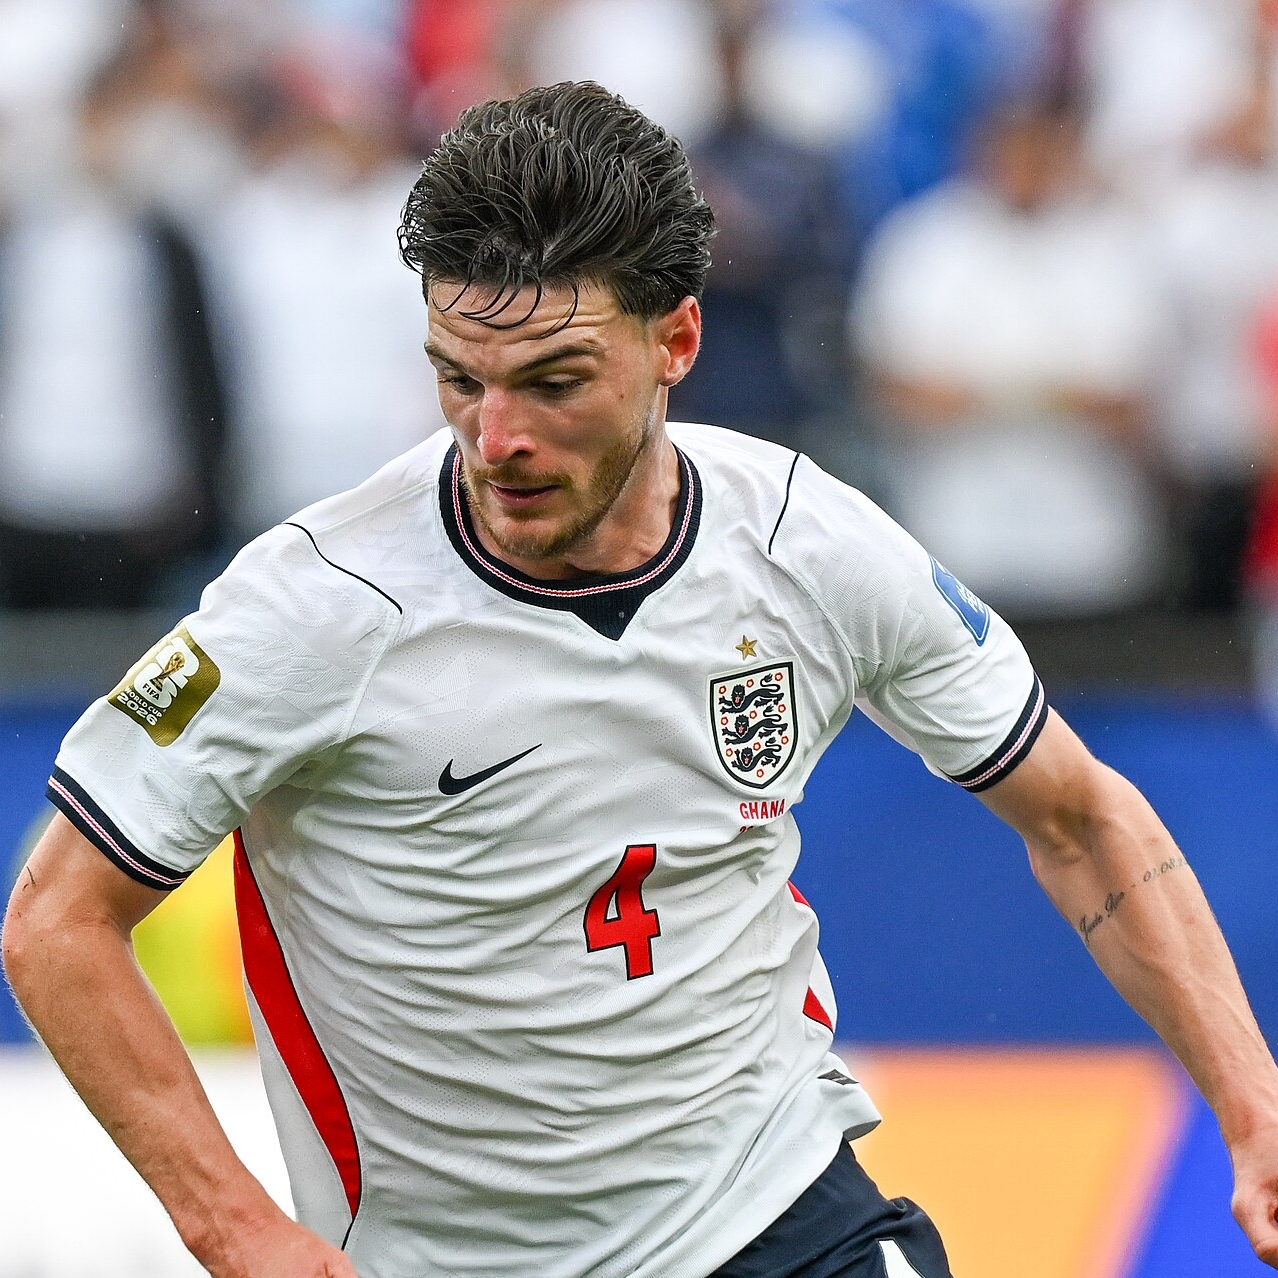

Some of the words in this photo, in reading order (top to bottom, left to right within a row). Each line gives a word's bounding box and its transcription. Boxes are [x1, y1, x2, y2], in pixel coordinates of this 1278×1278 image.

[116, 691, 159, 727] 2026
[124, 685, 149, 708] WORLD
[147, 704, 163, 719] CUP
[142, 683, 161, 701] FIFA
[739, 798, 786, 820] GHANA
[583, 843, 662, 981] 4
